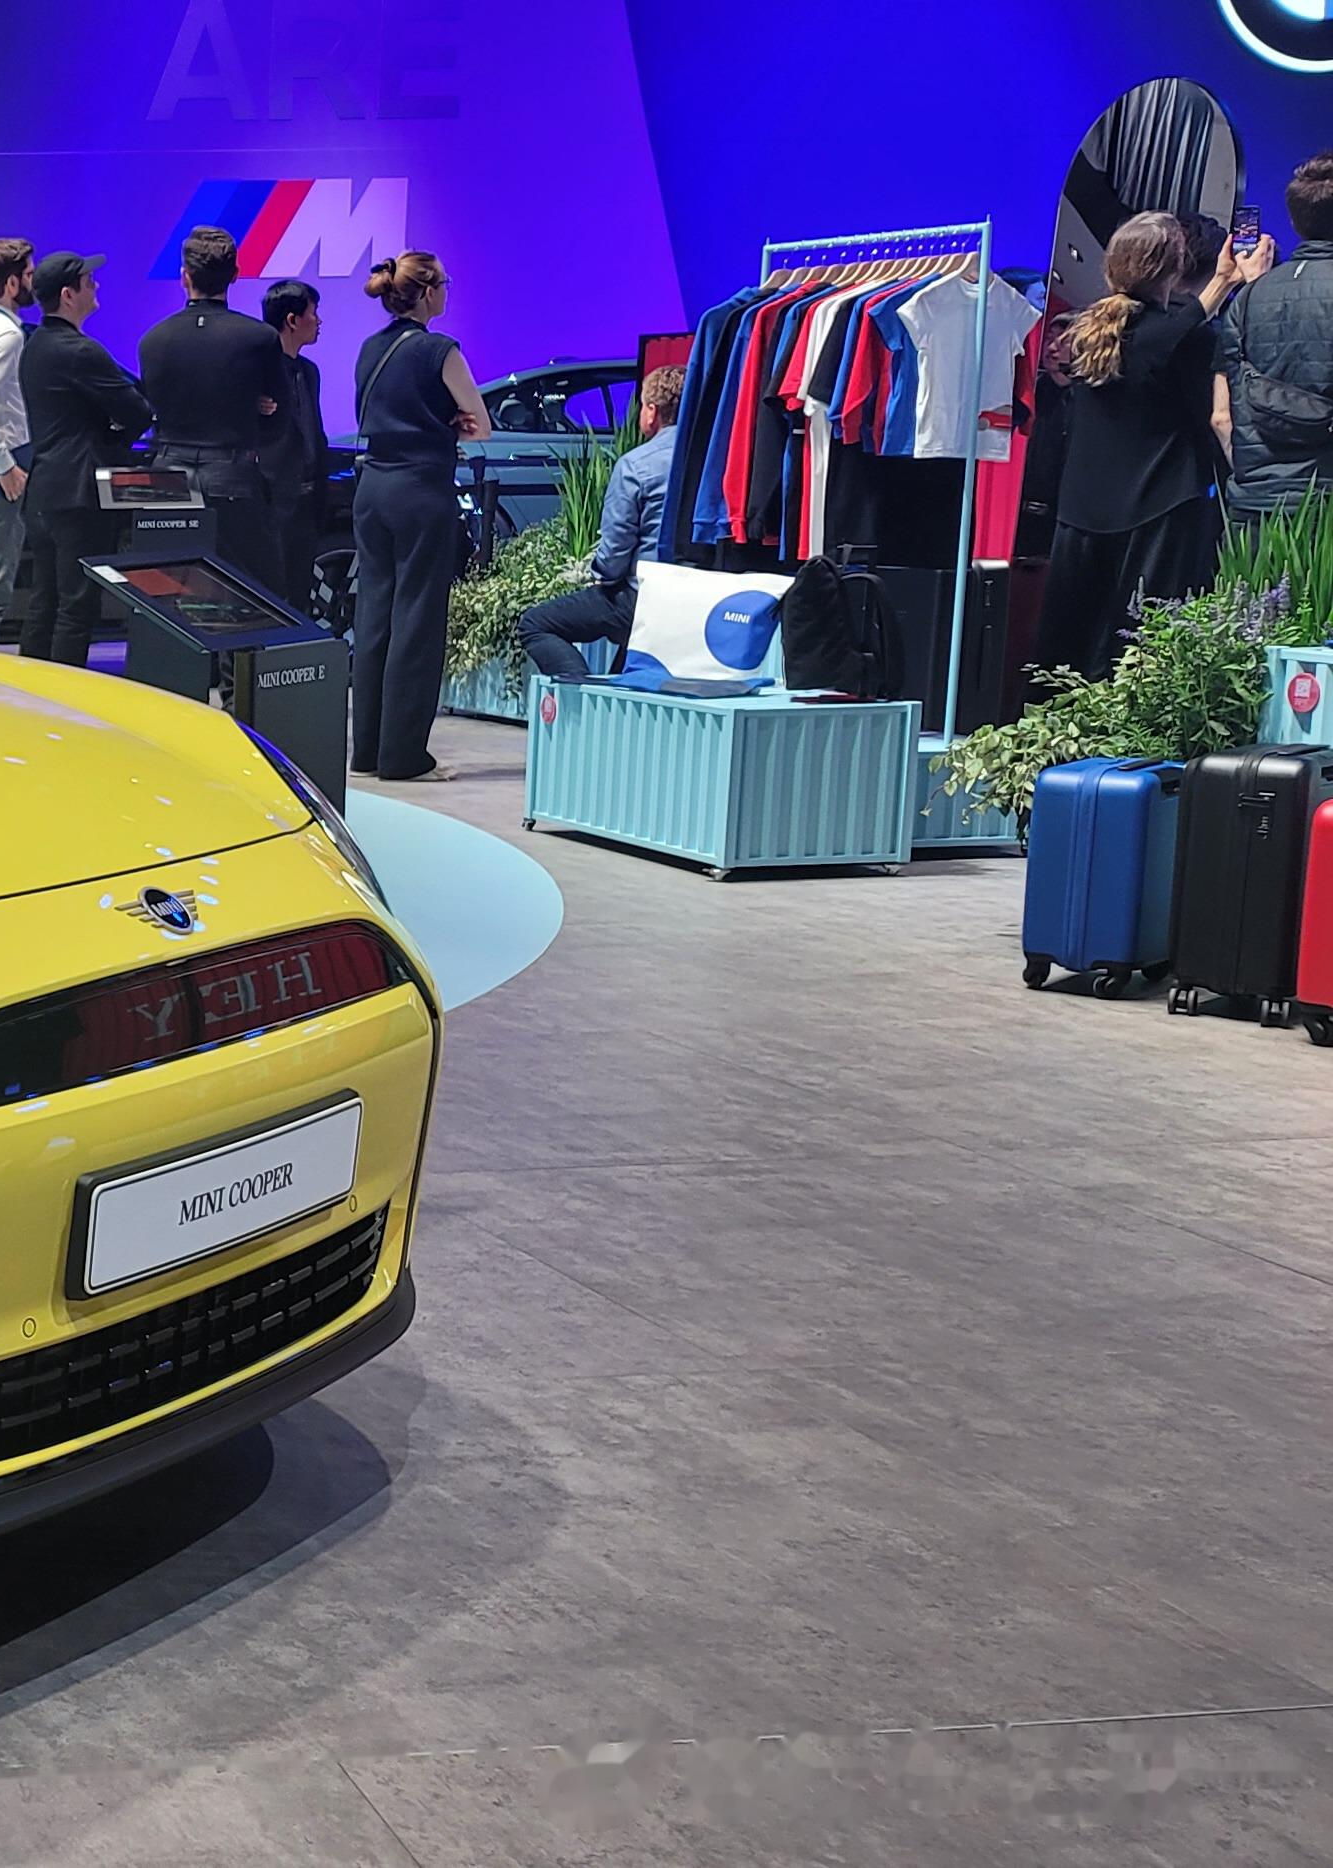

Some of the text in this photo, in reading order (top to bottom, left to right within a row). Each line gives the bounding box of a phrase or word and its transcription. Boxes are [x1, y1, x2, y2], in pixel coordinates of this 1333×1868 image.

[145, 0, 460, 121] ARE
[137, 520, 156, 529] MINI
[156, 520, 187, 529] COOPER
[723, 611, 751, 624] MINI
[257, 664, 326, 688] MINI COOPER E
[178, 1162, 293, 1226] MINI COOPER
